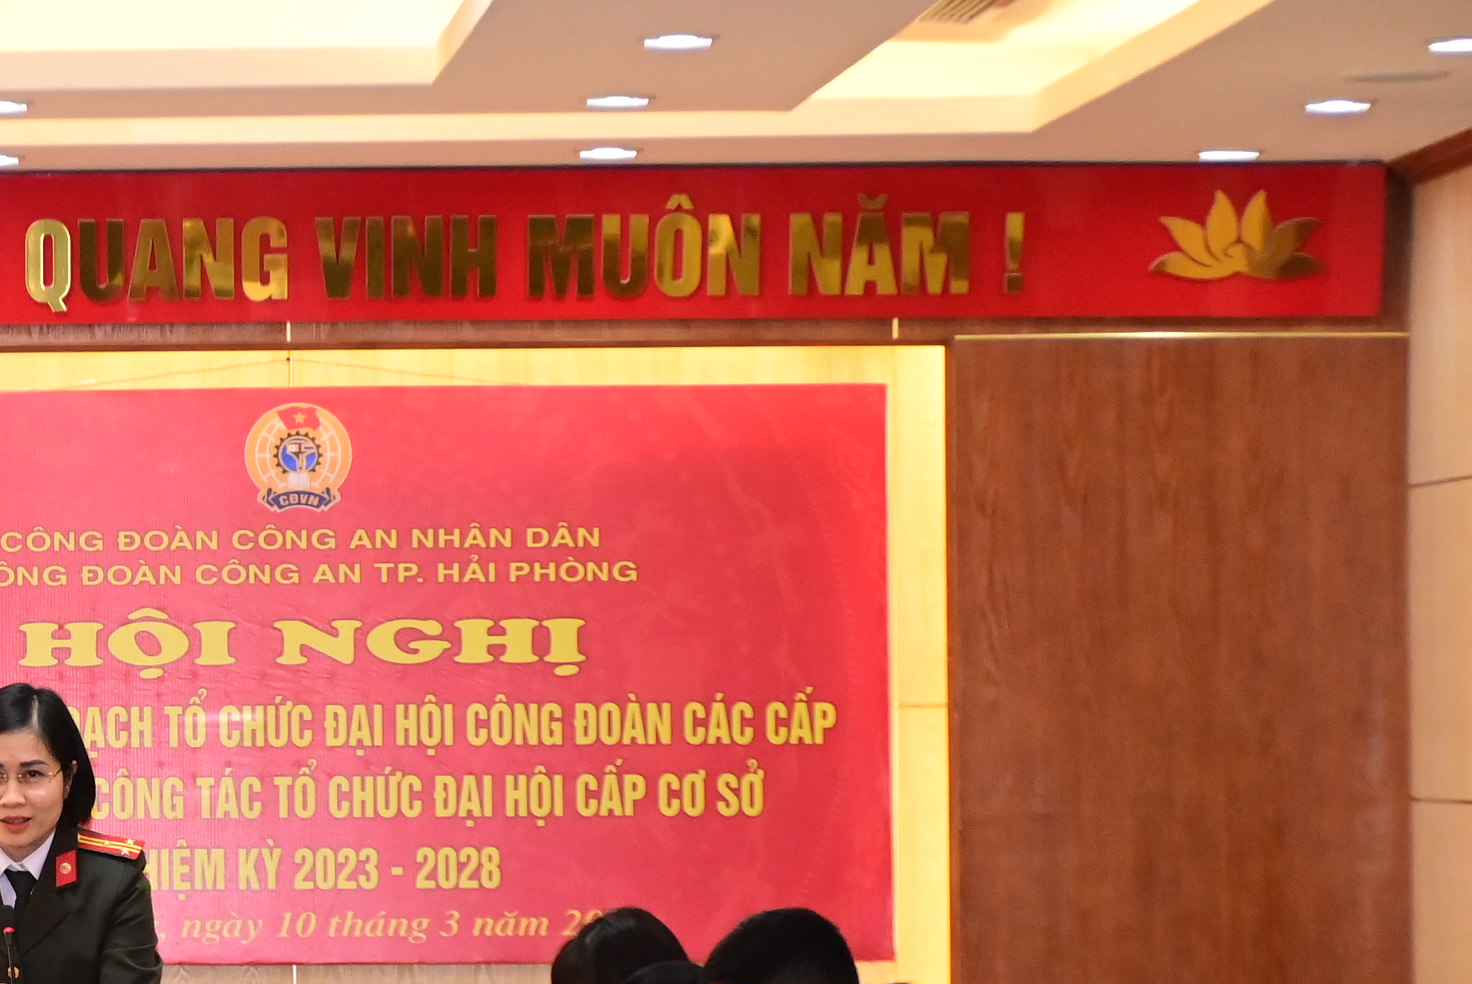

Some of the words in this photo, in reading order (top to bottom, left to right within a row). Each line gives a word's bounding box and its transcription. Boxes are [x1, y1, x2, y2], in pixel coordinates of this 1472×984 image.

[25, 217, 289, 312] QUANG
[315, 215, 497, 299] VINH
[527, 193, 762, 297] MUÔN
[789, 193, 970, 295] NĂM
[1005, 212, 1026, 294] !
[0, 526, 104, 552] CÔNG
[117, 525, 219, 551] ĐOÀN
[232, 524, 336, 550] CÔNG
[349, 529, 398, 549] AN
[411, 523, 512, 548] NHÂN
[526, 522, 600, 548] DÂN
[81, 560, 182, 585] ĐOÀN
[195, 559, 299, 585] CÔNG
[312, 563, 361, 583] AN
[374, 562, 424, 583] TP.
[437, 554, 496, 583] HẢI
[509, 556, 638, 582] PHÒNG
[18, 607, 237, 679] HỘI
[273, 617, 587, 676] NGHỊ
[164, 688, 208, 748] TỔ
[218, 695, 313, 748] CHỨC
[324, 703, 384, 756] ĐẠI
[395, 694, 454, 756] HỘI
[466, 694, 563, 746] CÔNG
[574, 693, 672, 745] ĐOÀN
[684, 693, 755, 745] CÁC
[765, 686, 837, 745] CẤP
[90, 768, 185, 820] CÔNG
[196, 767, 263, 819] TÁC
[274, 759, 317, 819] TỔ
[328, 766, 423, 818] CHỨC
[433, 774, 493, 827] ĐẠI
[505, 765, 564, 827] HỘI
[576, 758, 647, 817] CẤP
[657, 769, 706, 818] CƠ
[717, 758, 765, 817] SỞ
[238, 838, 282, 891] KỲ
[293, 846, 380, 890] 2023
[415, 846, 502, 890] 2028
[181, 911, 263, 944] ngày
[276, 911, 318, 938] 10
[329, 909, 431, 944] tháng
[439, 910, 461, 937] 3
[472, 911, 550, 937] năm
